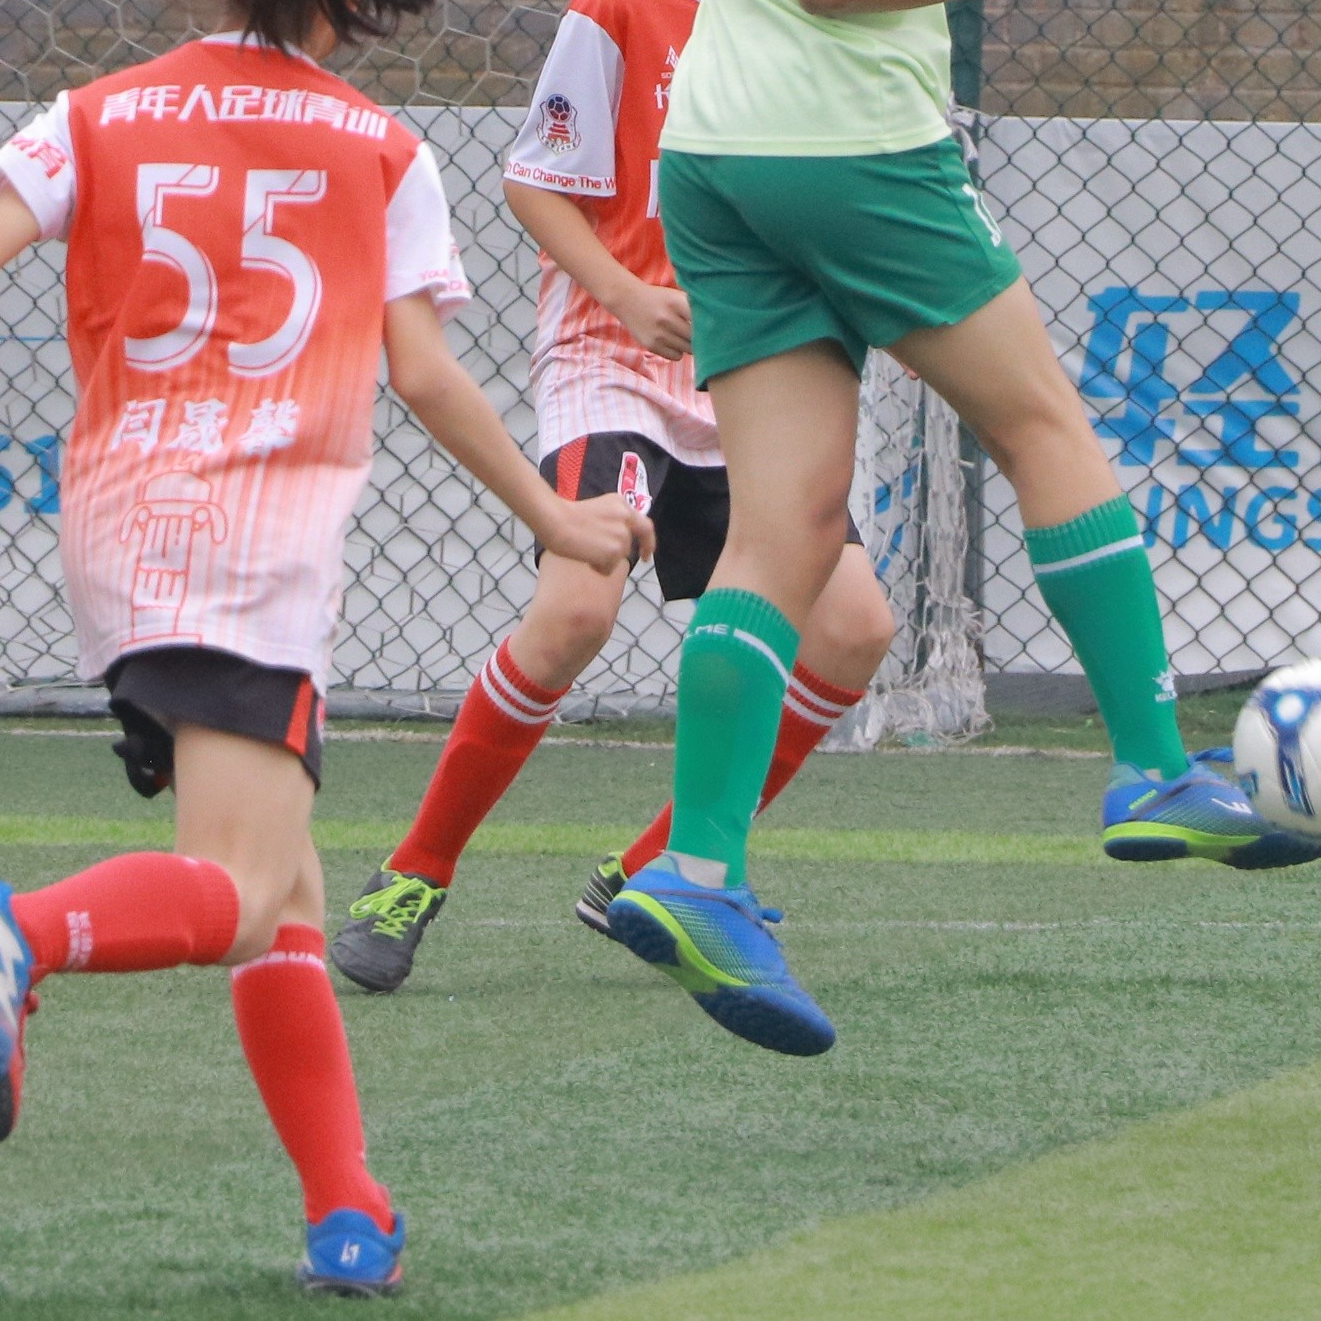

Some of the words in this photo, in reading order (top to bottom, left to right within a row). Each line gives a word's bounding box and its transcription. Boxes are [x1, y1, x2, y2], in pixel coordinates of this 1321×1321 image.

[100, 83, 389, 140] 青年人足球青训
[512, 162, 532, 178] Can
[533, 167, 576, 187] Change
[578, 175, 602, 189] The
[121, 162, 328, 376] 55
